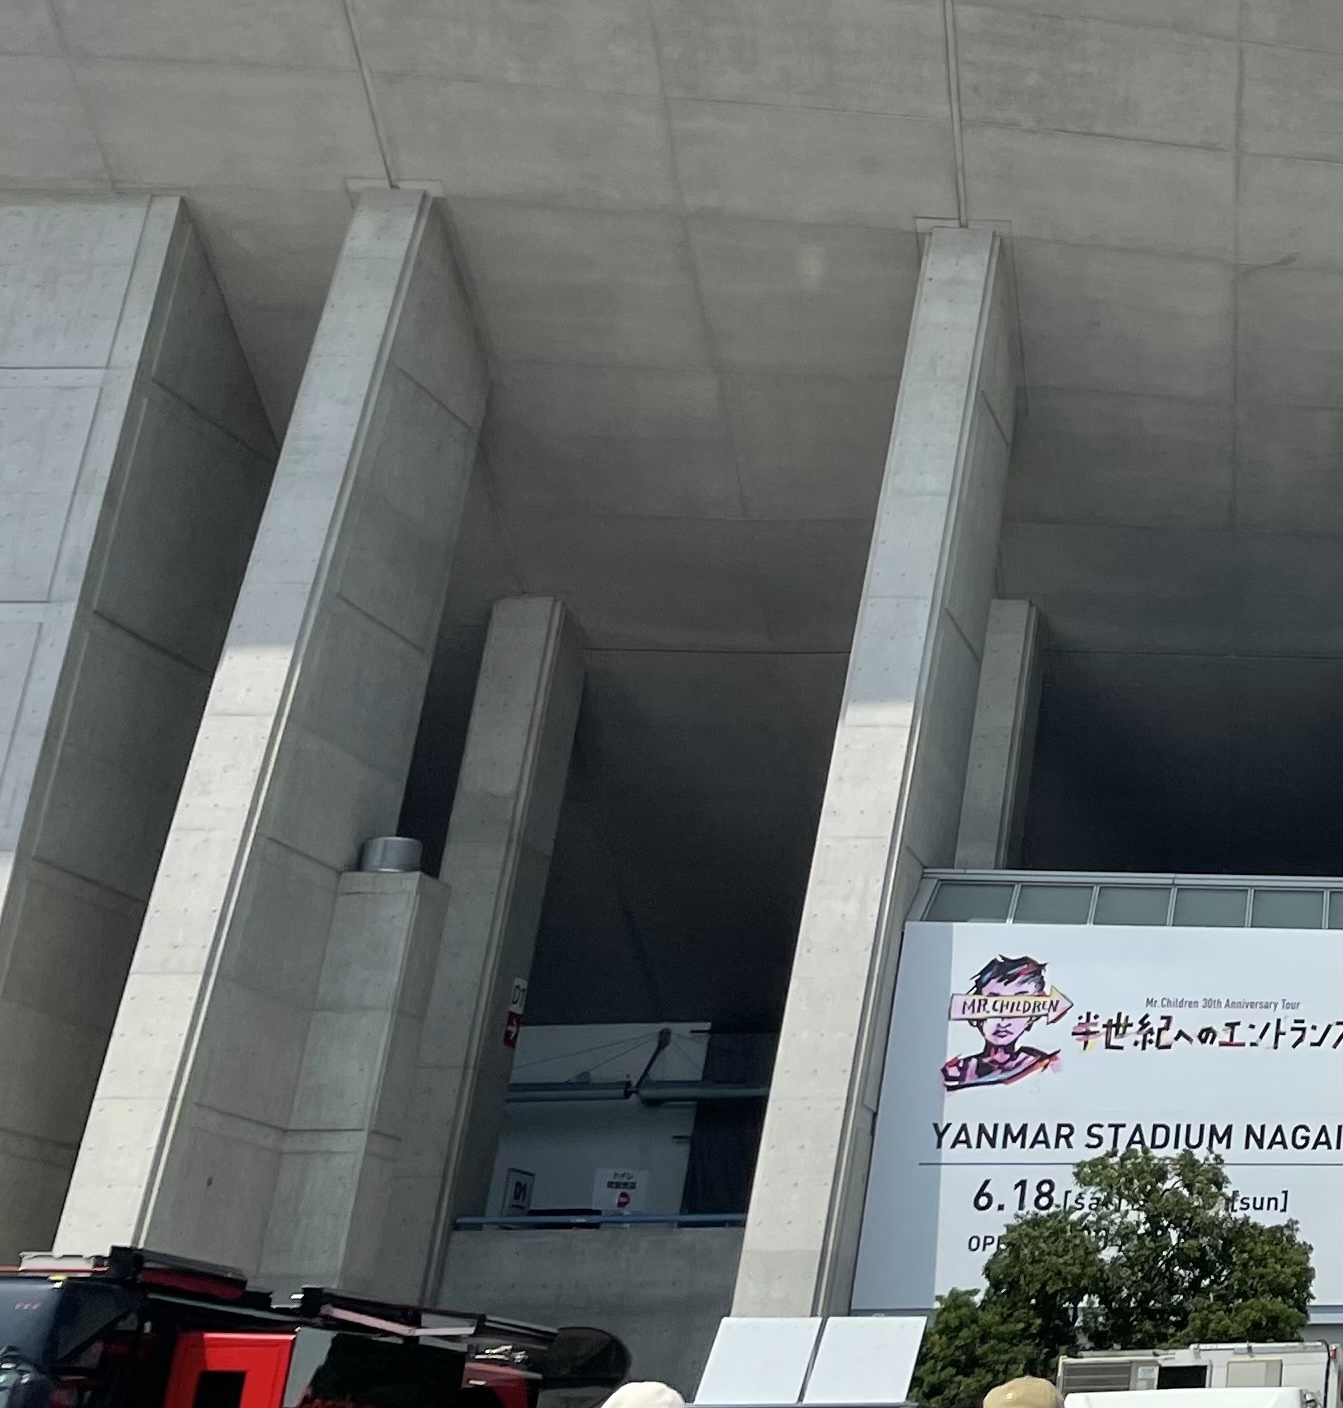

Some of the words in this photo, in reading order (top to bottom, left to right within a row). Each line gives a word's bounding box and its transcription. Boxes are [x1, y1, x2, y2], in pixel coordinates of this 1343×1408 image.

[1202, 998, 1222, 1009] 30th
[1224, 998, 1278, 1012] Anniversary
[1281, 999, 1300, 1010] Tour
[932, 1122, 1074, 1149] YANMAR
[1085, 1123, 1234, 1150] STADIUM
[1244, 1124, 1343, 1150] NAGAI
[973, 1178, 1055, 1212] 6.18
